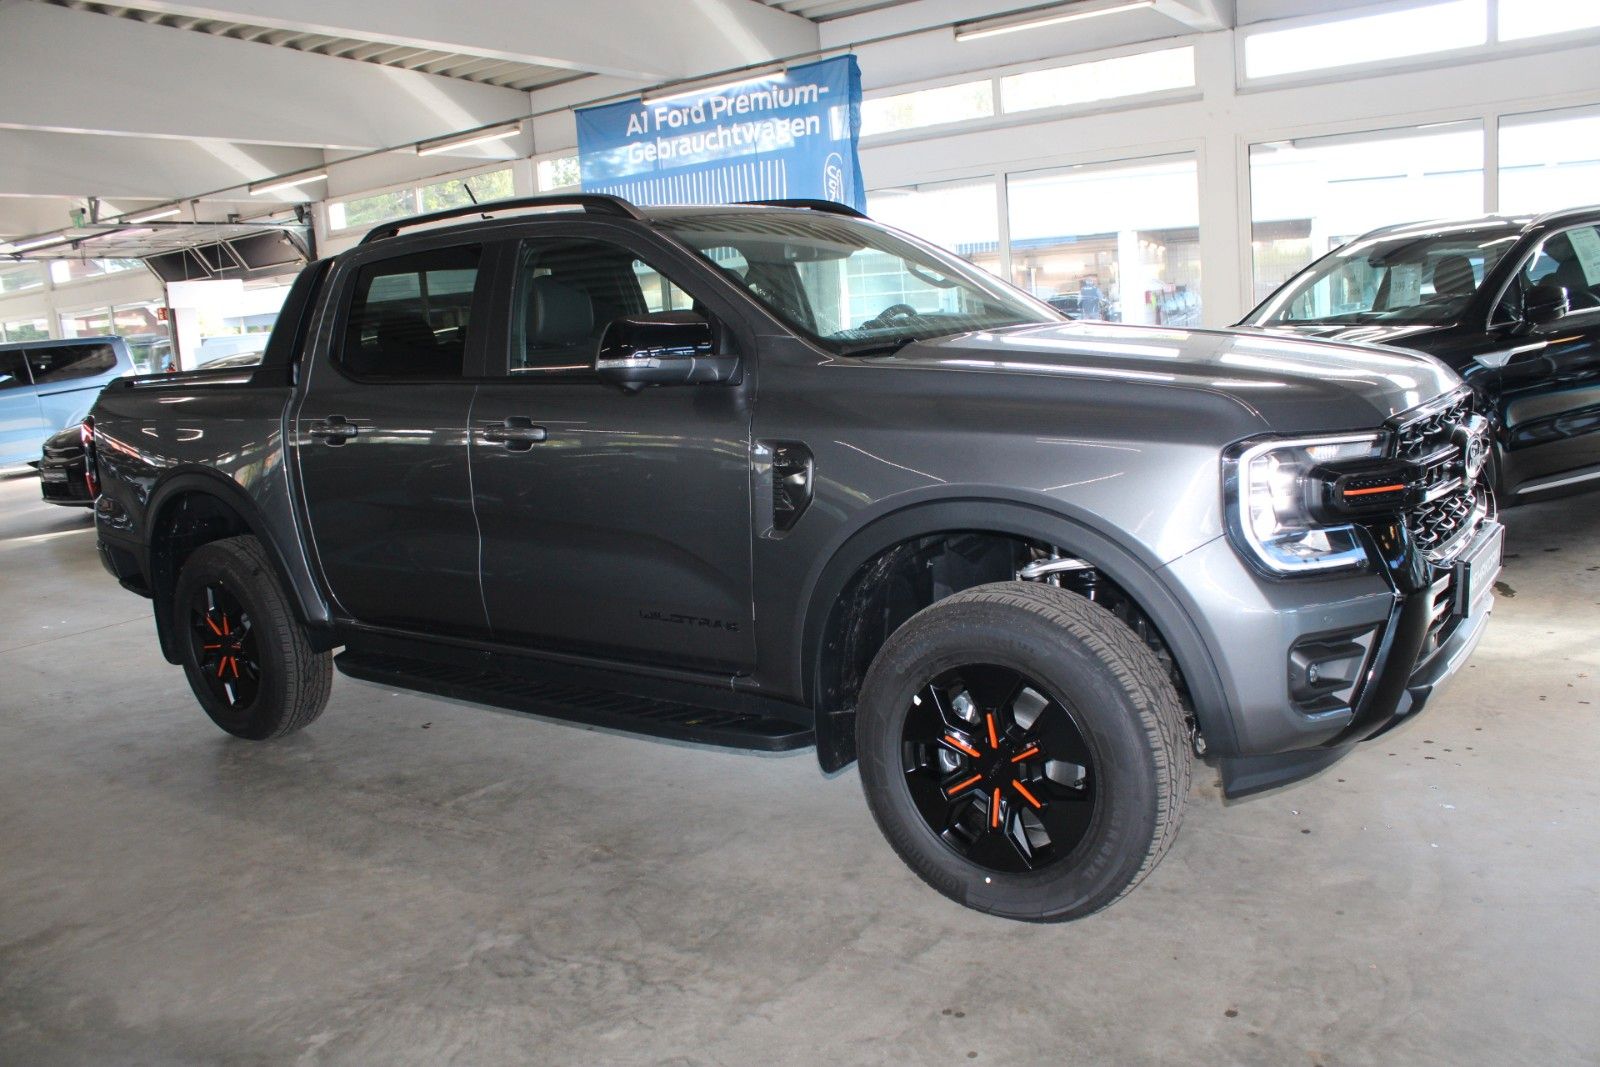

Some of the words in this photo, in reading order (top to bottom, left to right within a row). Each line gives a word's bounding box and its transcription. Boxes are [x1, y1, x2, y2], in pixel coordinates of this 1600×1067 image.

[626, 110, 648, 136] A1
[655, 98, 706, 130] Ford
[710, 83, 830, 120] Premium-
[628, 115, 820, 164] Gebrauchtwagen
